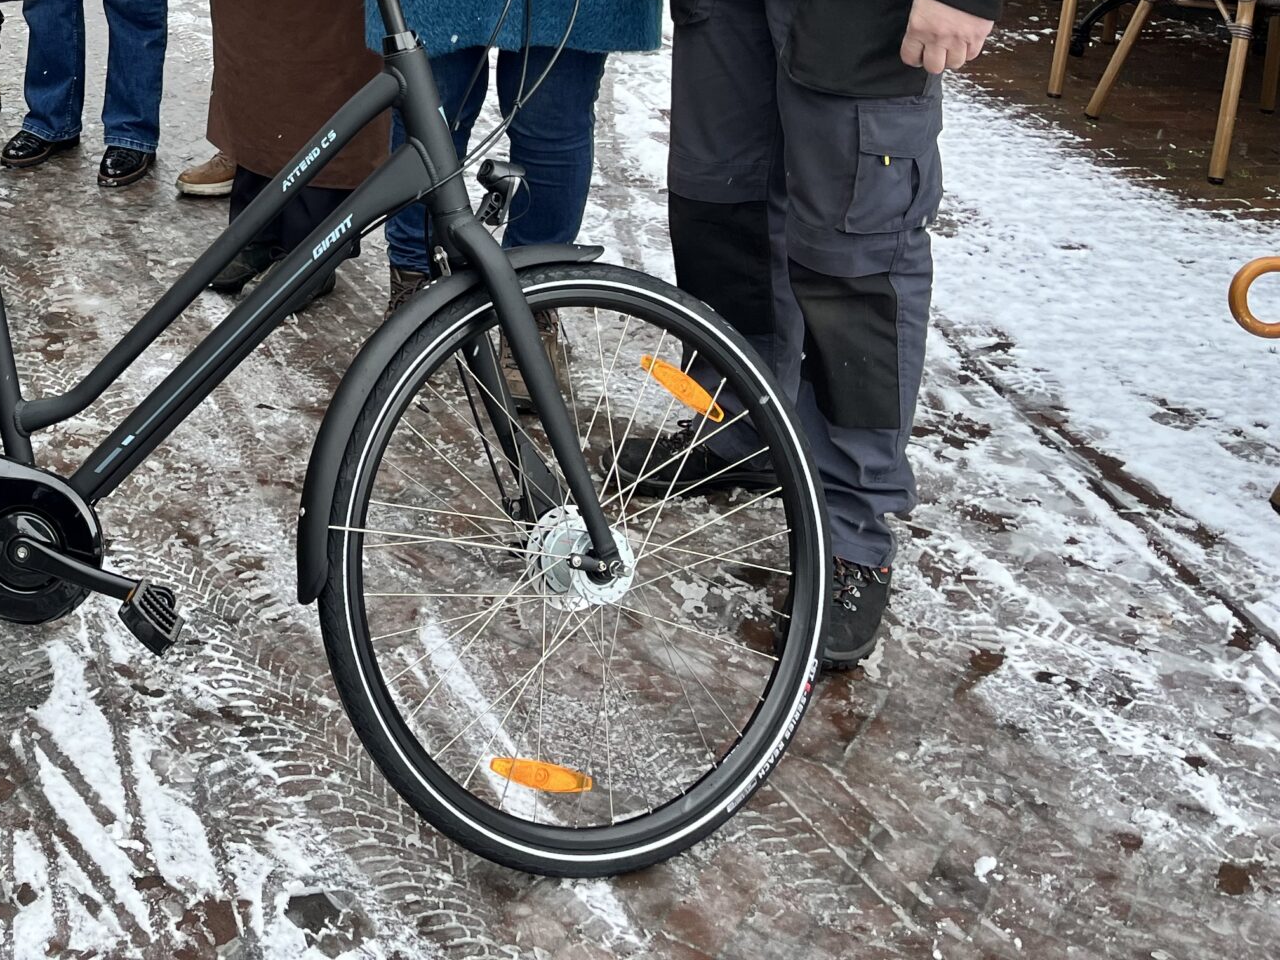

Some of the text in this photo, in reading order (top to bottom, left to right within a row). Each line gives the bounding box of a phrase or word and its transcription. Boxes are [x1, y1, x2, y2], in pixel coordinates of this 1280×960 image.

[282, 129, 338, 193] ATTEND CS
[312, 213, 353, 260] GIANT
[757, 741, 786, 780] REACH
